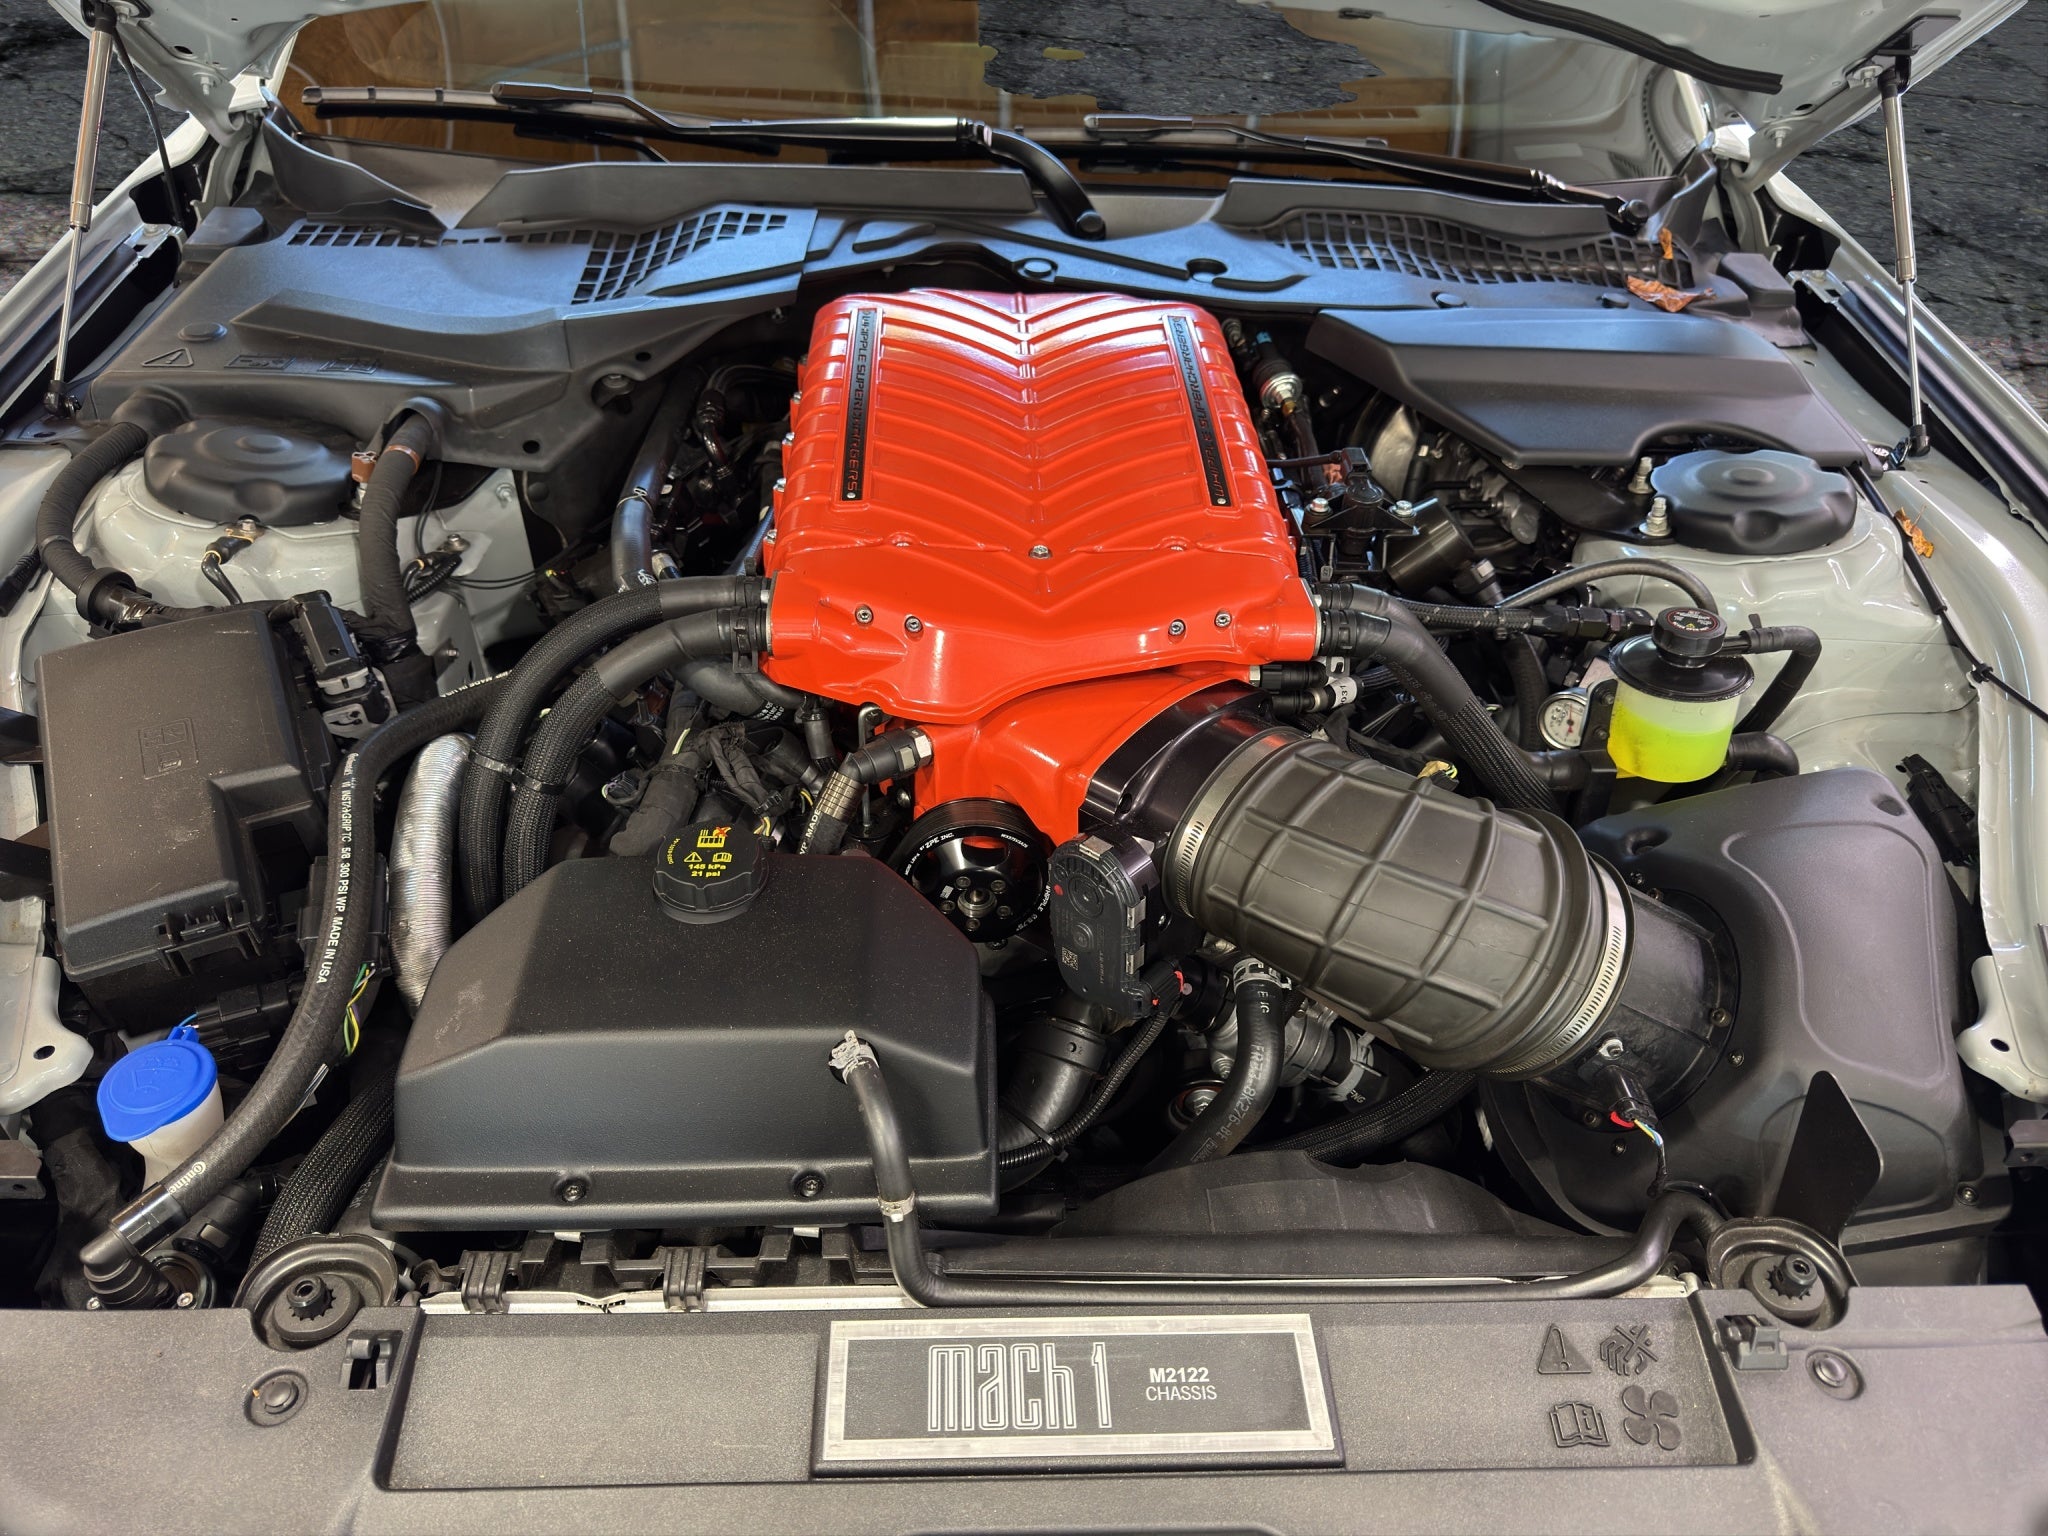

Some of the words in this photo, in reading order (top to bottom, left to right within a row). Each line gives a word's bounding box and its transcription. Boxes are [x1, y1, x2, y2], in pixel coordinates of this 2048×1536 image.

[857, 315, 870, 362] WHIPPLE
[1174, 322, 1208, 428] SUPERCHARGERS
[847, 364, 867, 491] SUPERCHARGERS
[805, 809, 821, 838] MADE
[339, 862, 351, 878] 300
[705, 870, 721, 878] psi
[338, 879, 349, 895] PSI
[335, 896, 348, 912] WP
[327, 916, 344, 947] MADE
[324, 948, 337, 960] IN
[316, 961, 333, 984] USA
[1149, 1366, 1211, 1383] M2122
[1091, 1341, 1112, 1429] 1
[1145, 1385, 1218, 1401] CHASSIS
